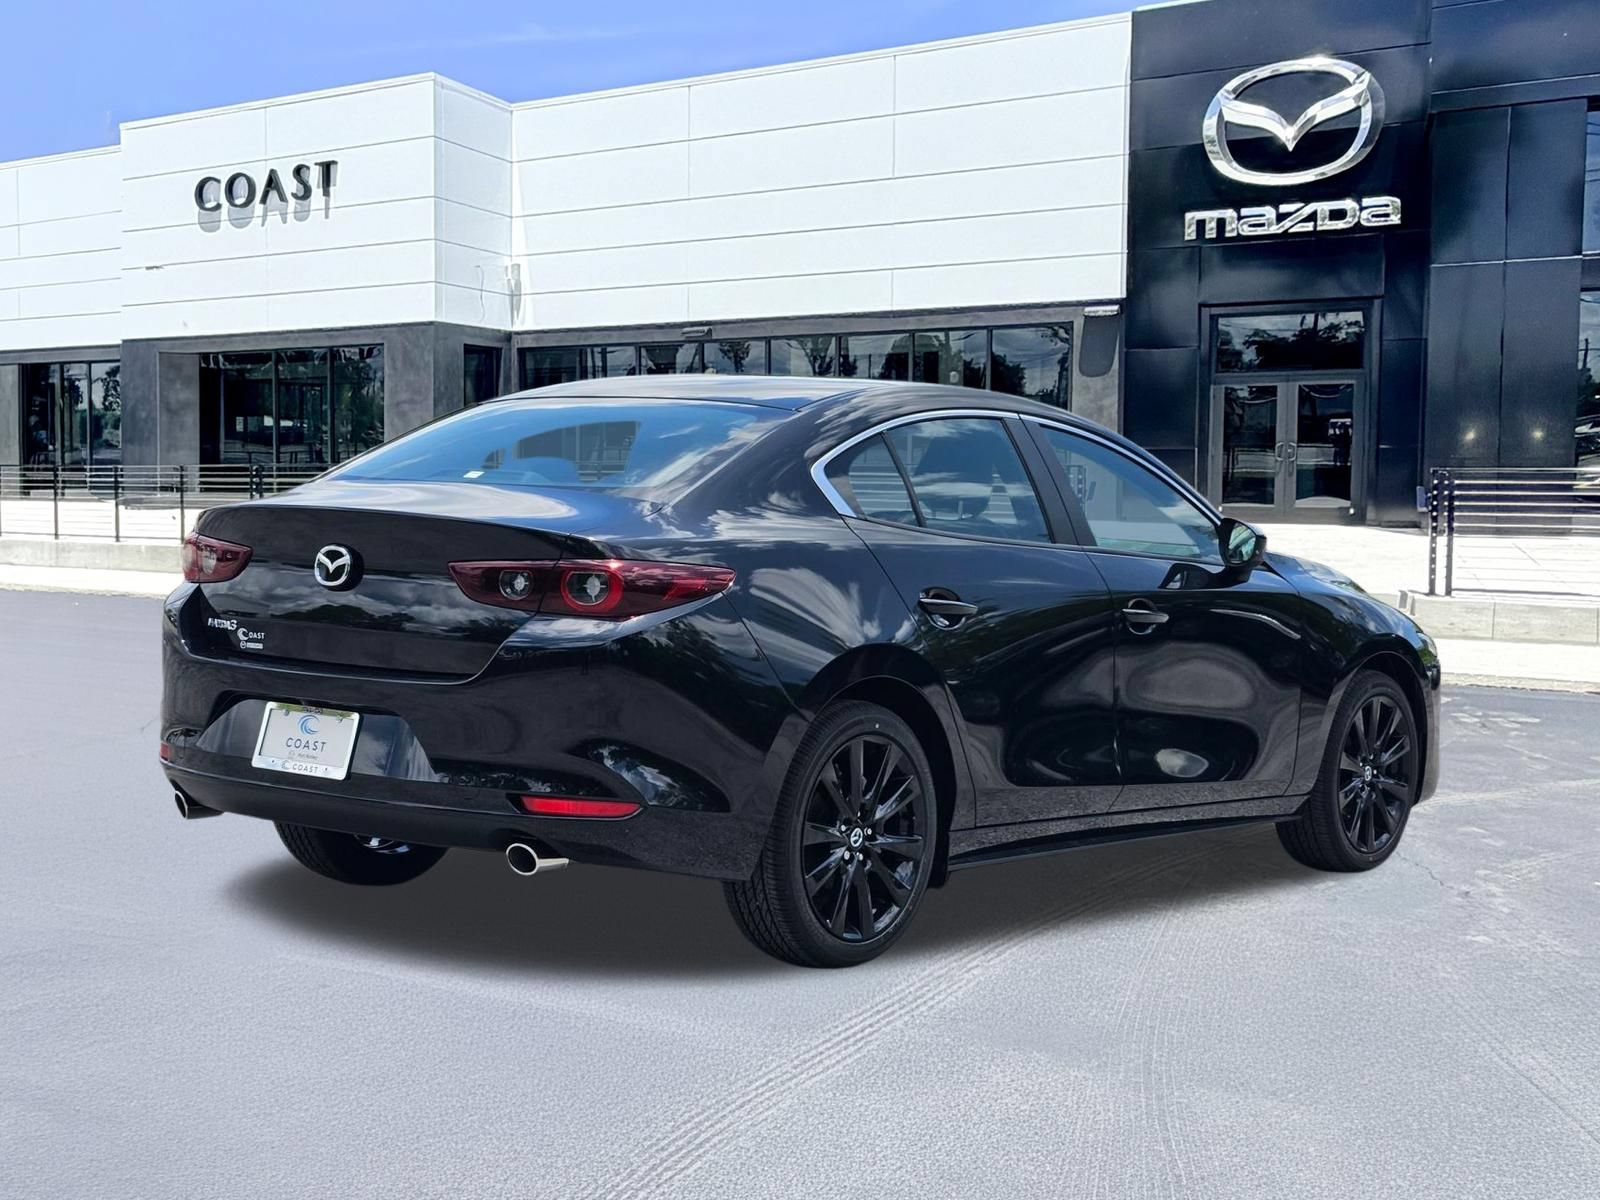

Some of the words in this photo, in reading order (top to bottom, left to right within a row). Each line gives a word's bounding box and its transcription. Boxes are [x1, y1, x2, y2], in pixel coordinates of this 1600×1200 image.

[194, 160, 338, 212] COAST
[285, 737, 327, 753] COAST
[292, 763, 319, 773] COAST
